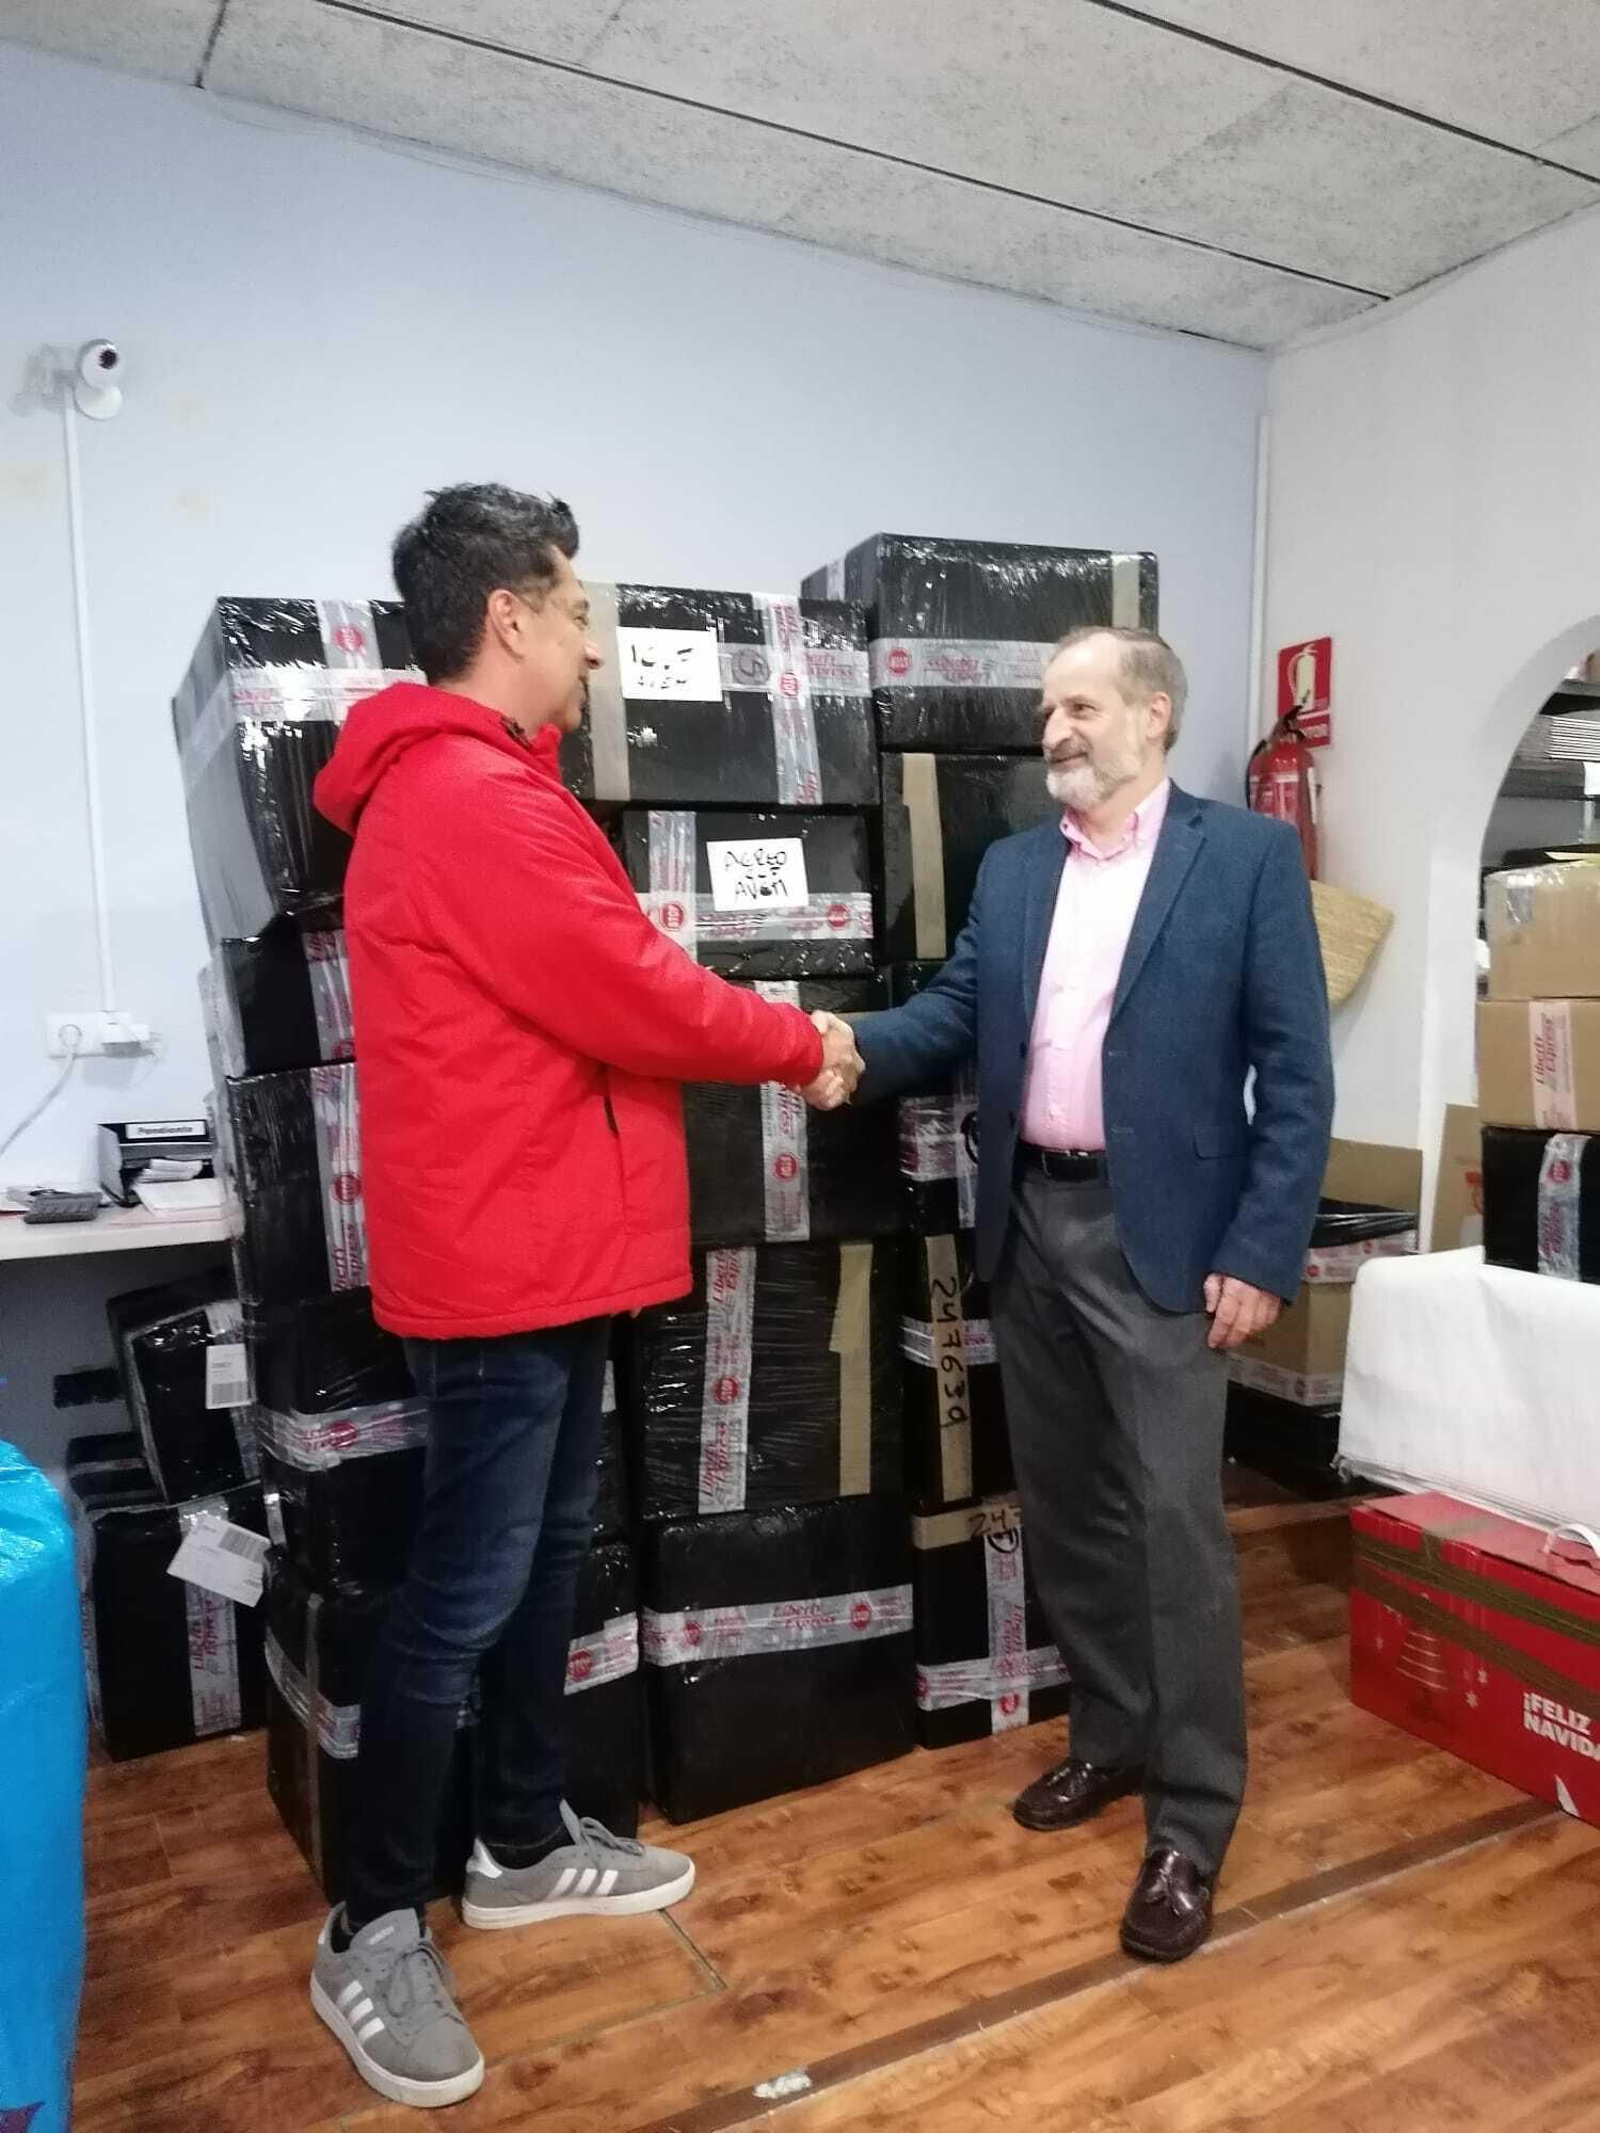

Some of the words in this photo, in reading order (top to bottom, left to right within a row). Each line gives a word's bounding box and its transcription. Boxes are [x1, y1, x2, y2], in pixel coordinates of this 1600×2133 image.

[667, 905, 680, 929] STOP
[930, 1276, 968, 1428] 247639
[702, 1441, 716, 1498] Liberty
[1523, 1692, 1591, 1736] ¡FELIZ
